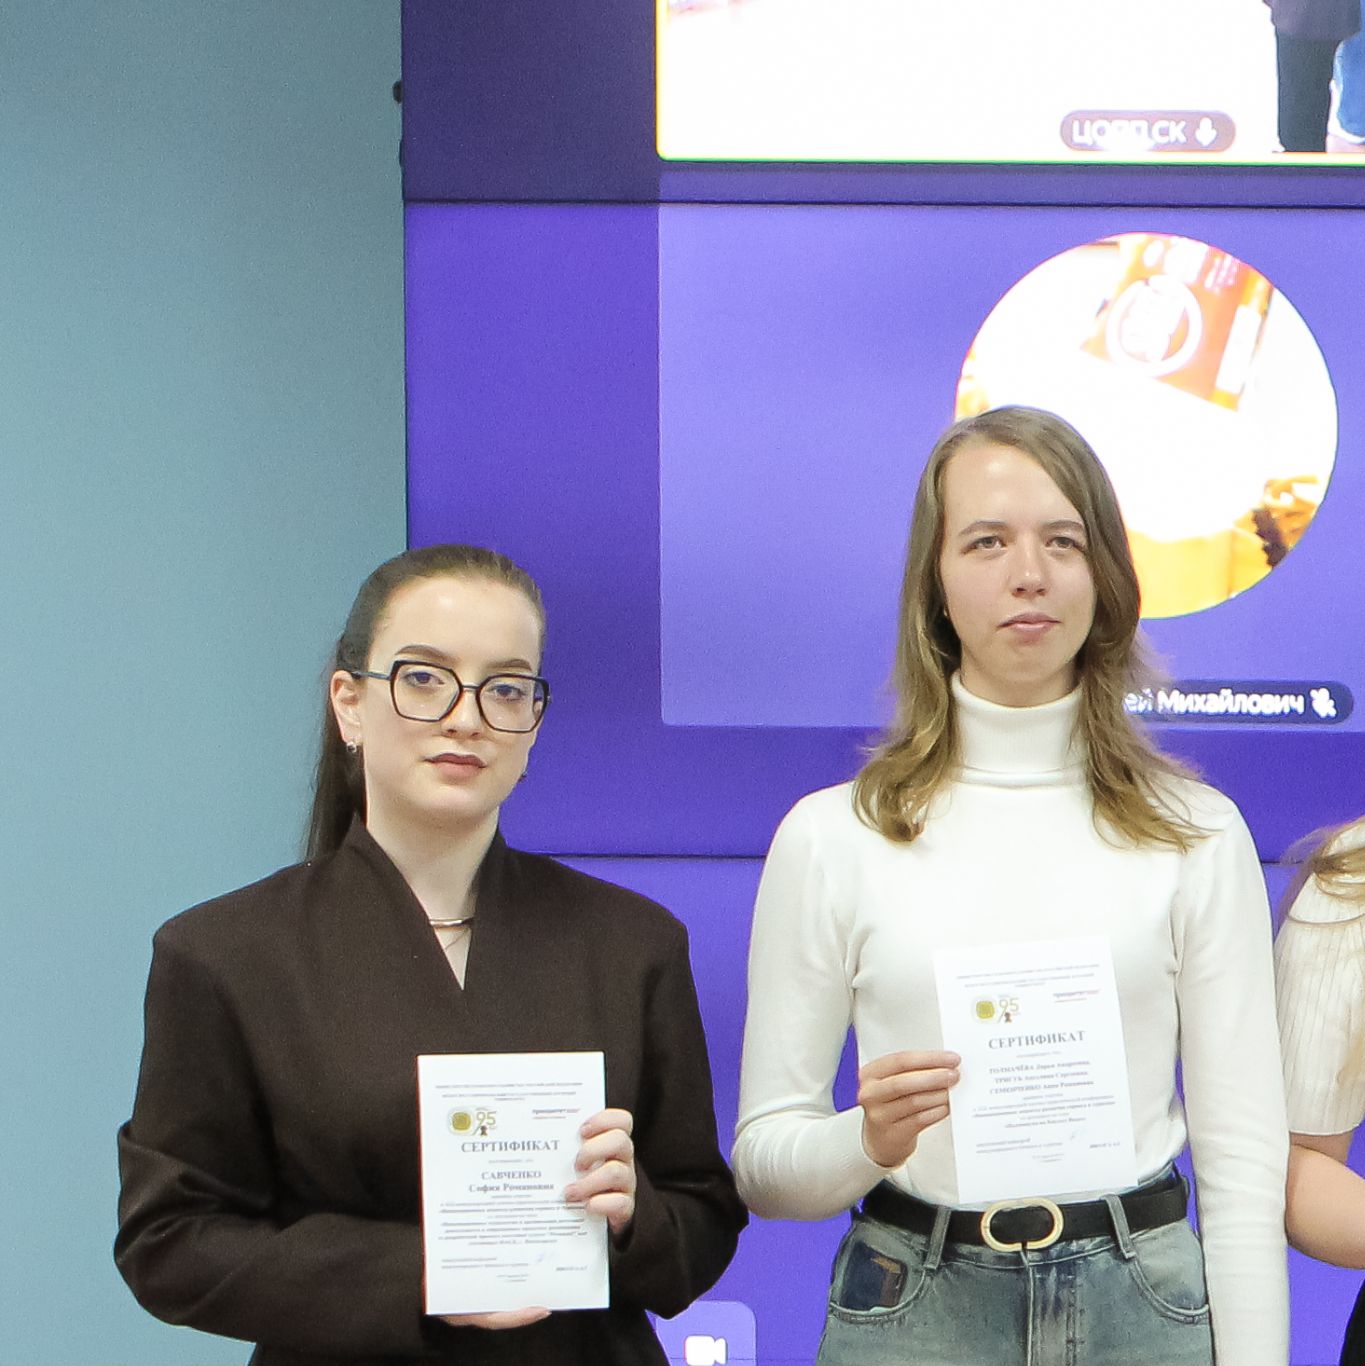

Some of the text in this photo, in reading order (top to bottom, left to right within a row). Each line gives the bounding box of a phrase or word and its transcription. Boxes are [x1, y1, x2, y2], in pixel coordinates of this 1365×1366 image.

[1156, 687, 1305, 715] Михайлович
[988, 1031, 1086, 1050] СЕРТИФИКАТ
[461, 1139, 561, 1153] СЕРТИФИКАТ
[481, 1170, 542, 1181] САВЧЕНКО
